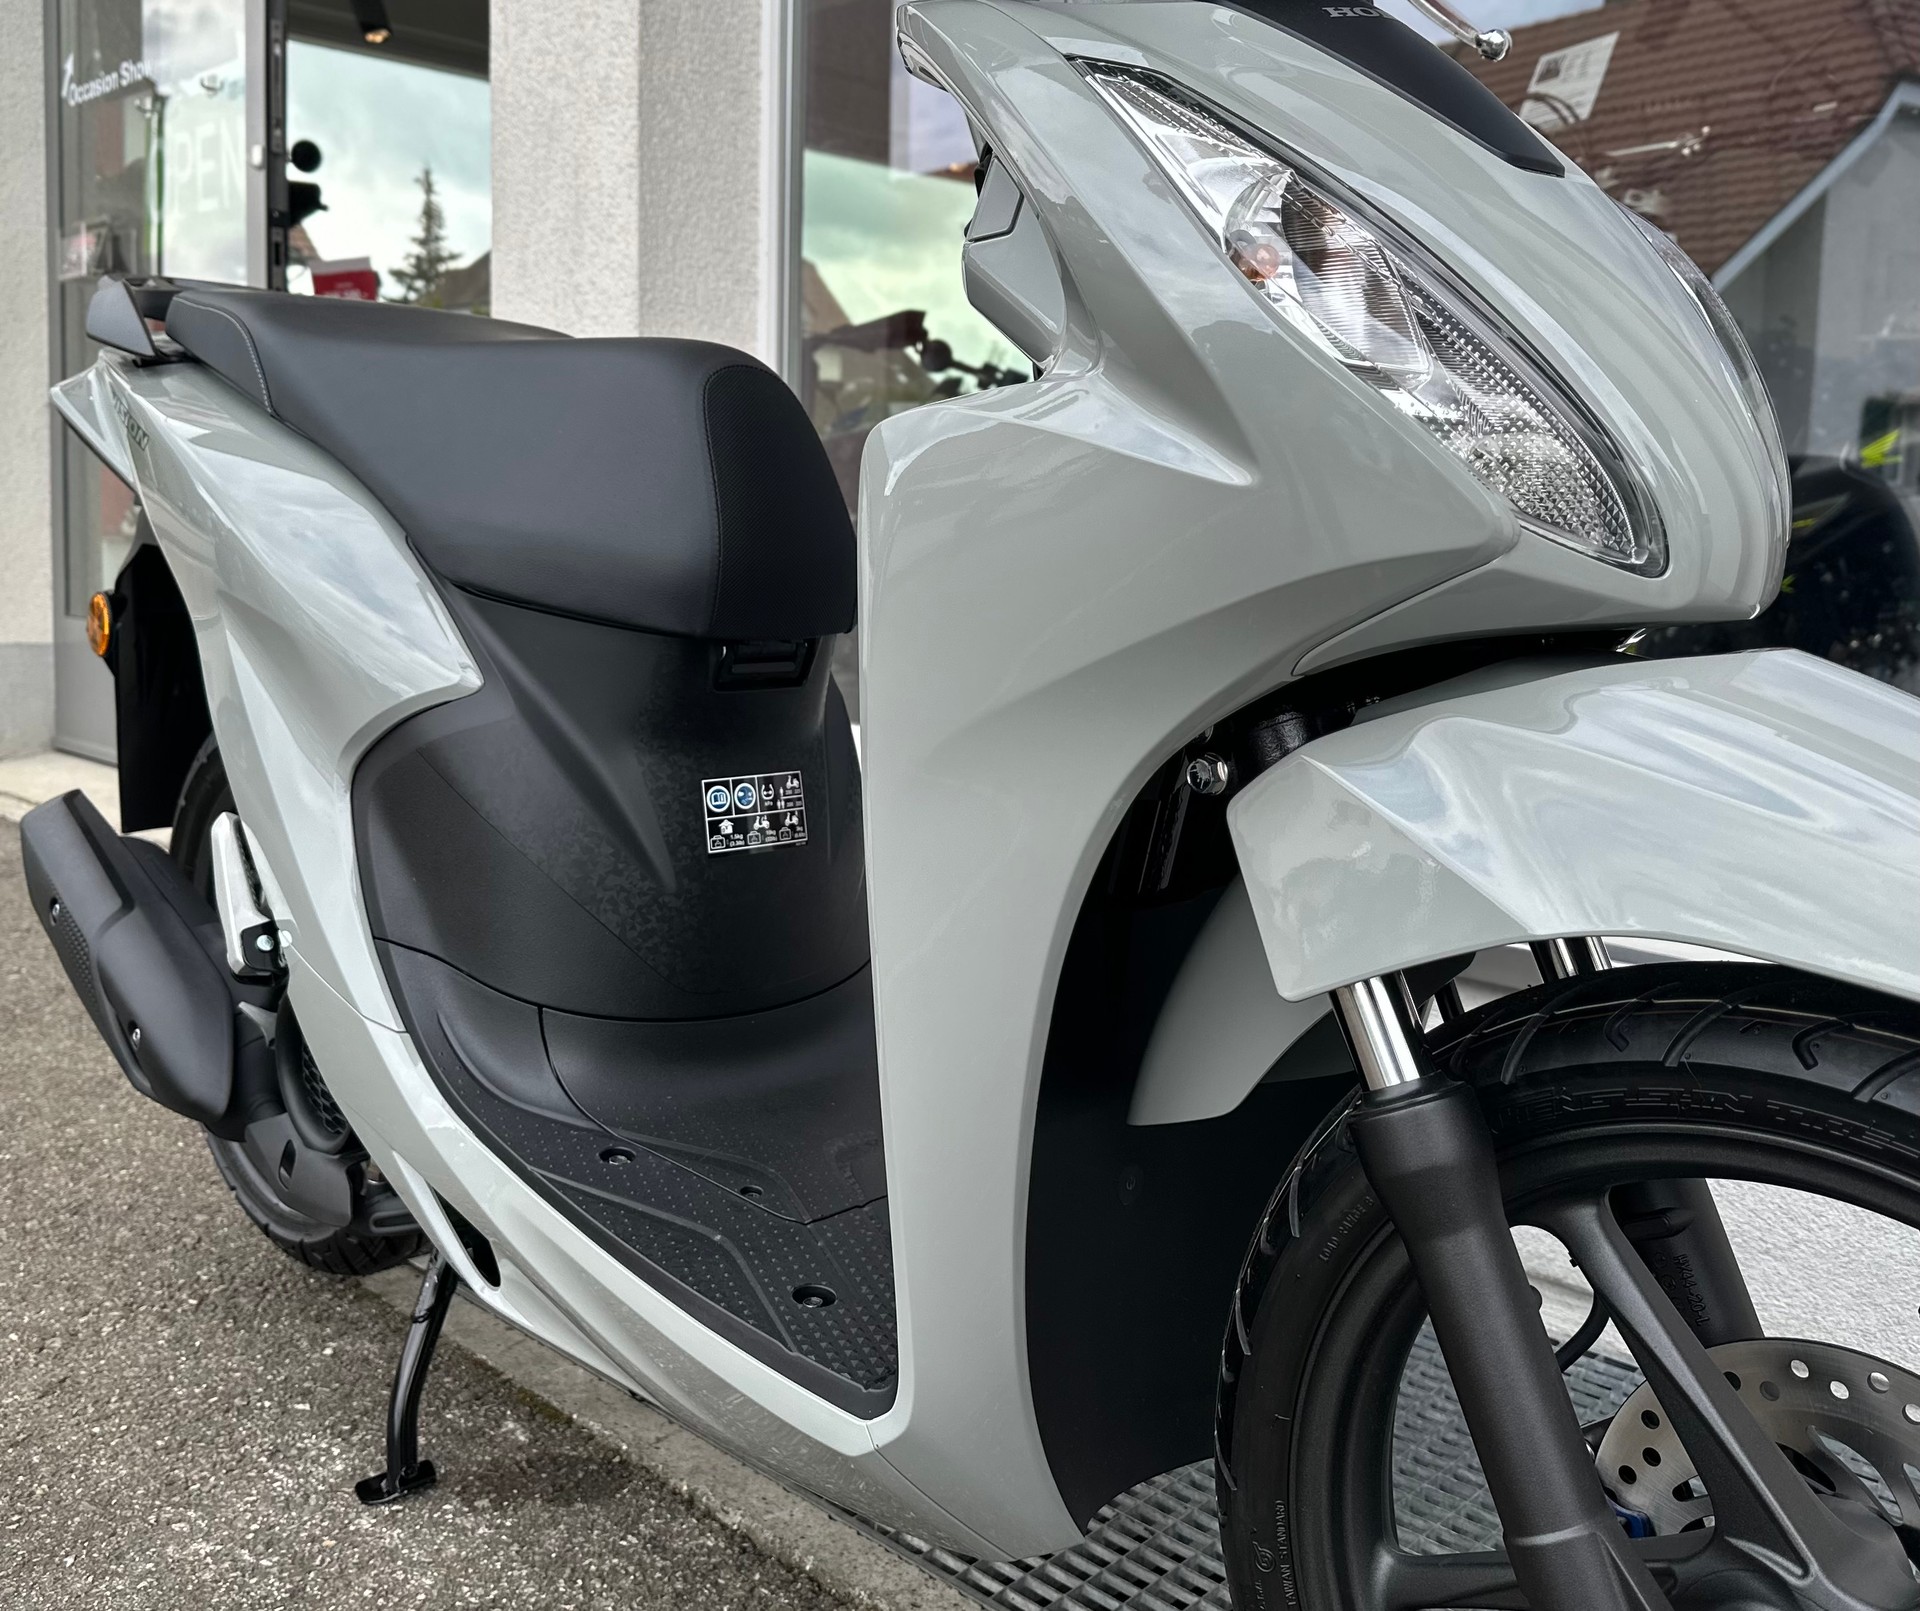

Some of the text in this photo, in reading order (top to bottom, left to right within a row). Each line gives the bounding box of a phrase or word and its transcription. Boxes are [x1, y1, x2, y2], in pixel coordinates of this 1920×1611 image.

[69, 71, 119, 106] Occasion
[167, 113, 246, 213] PEN
[114, 394, 149, 451] ISION
[1275, 1500, 1297, 1606] TAIWAN STANDARD
